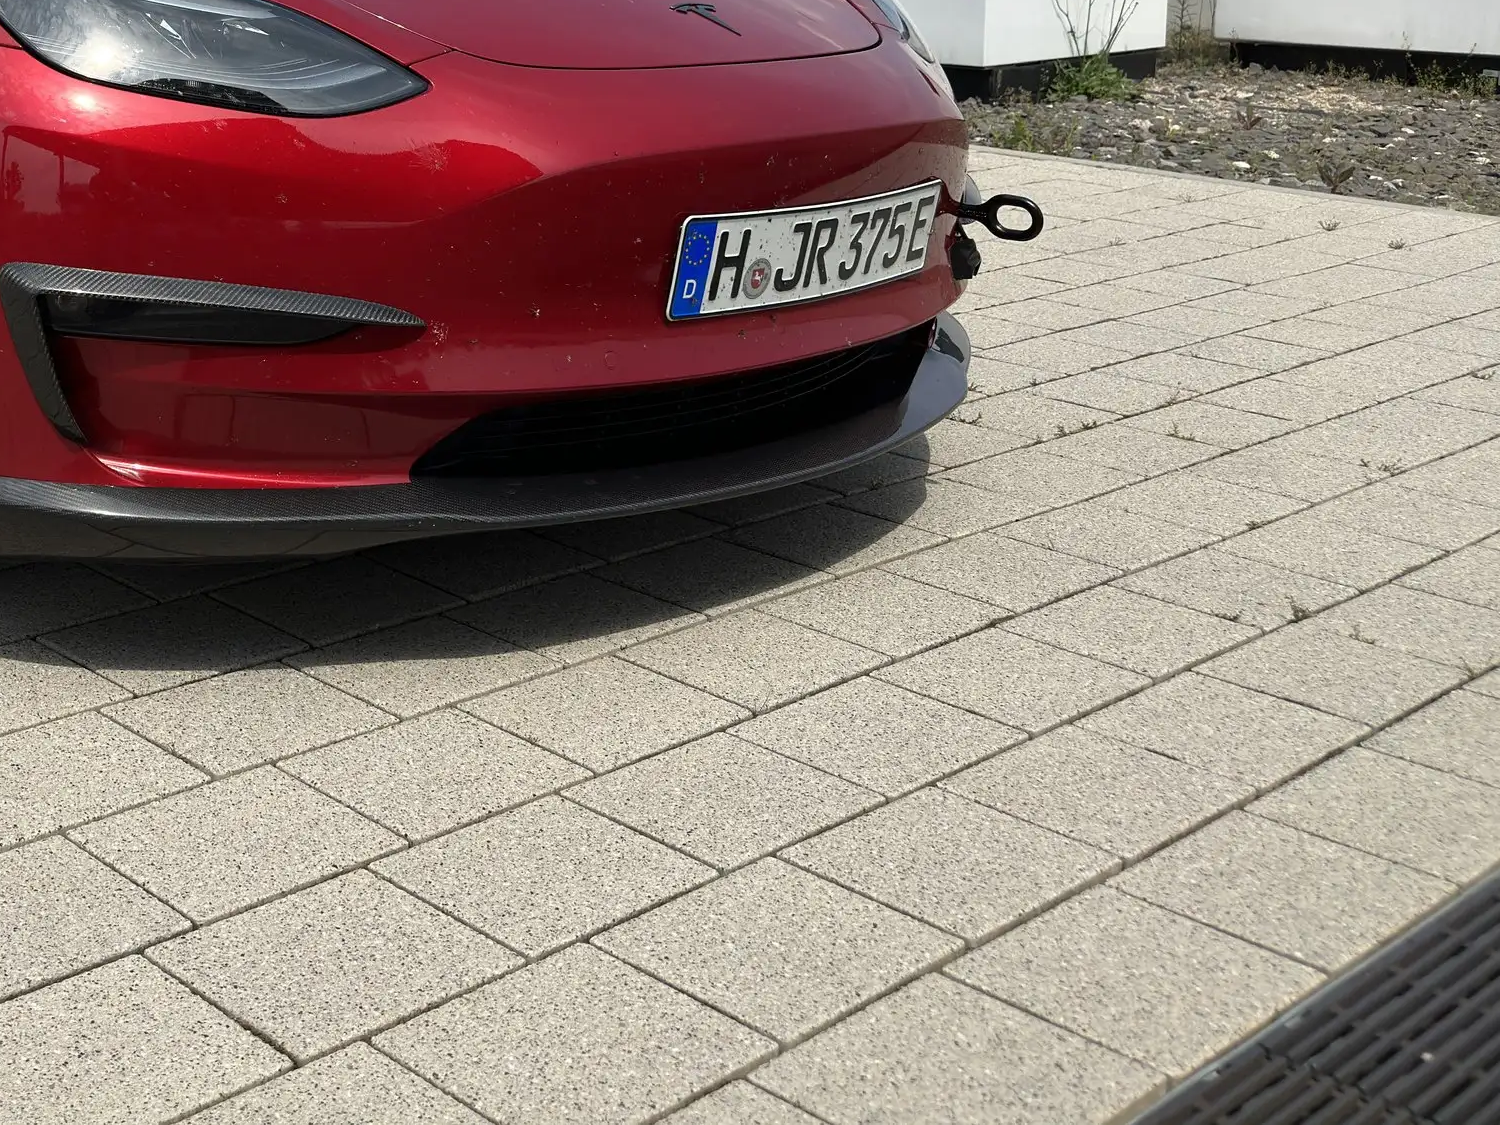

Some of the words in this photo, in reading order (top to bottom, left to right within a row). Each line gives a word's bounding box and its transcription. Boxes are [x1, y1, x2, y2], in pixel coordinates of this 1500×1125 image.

[708, 228, 751, 301] H
[774, 217, 839, 292] JR
[838, 194, 935, 280] 375E
[682, 279, 697, 299] D
